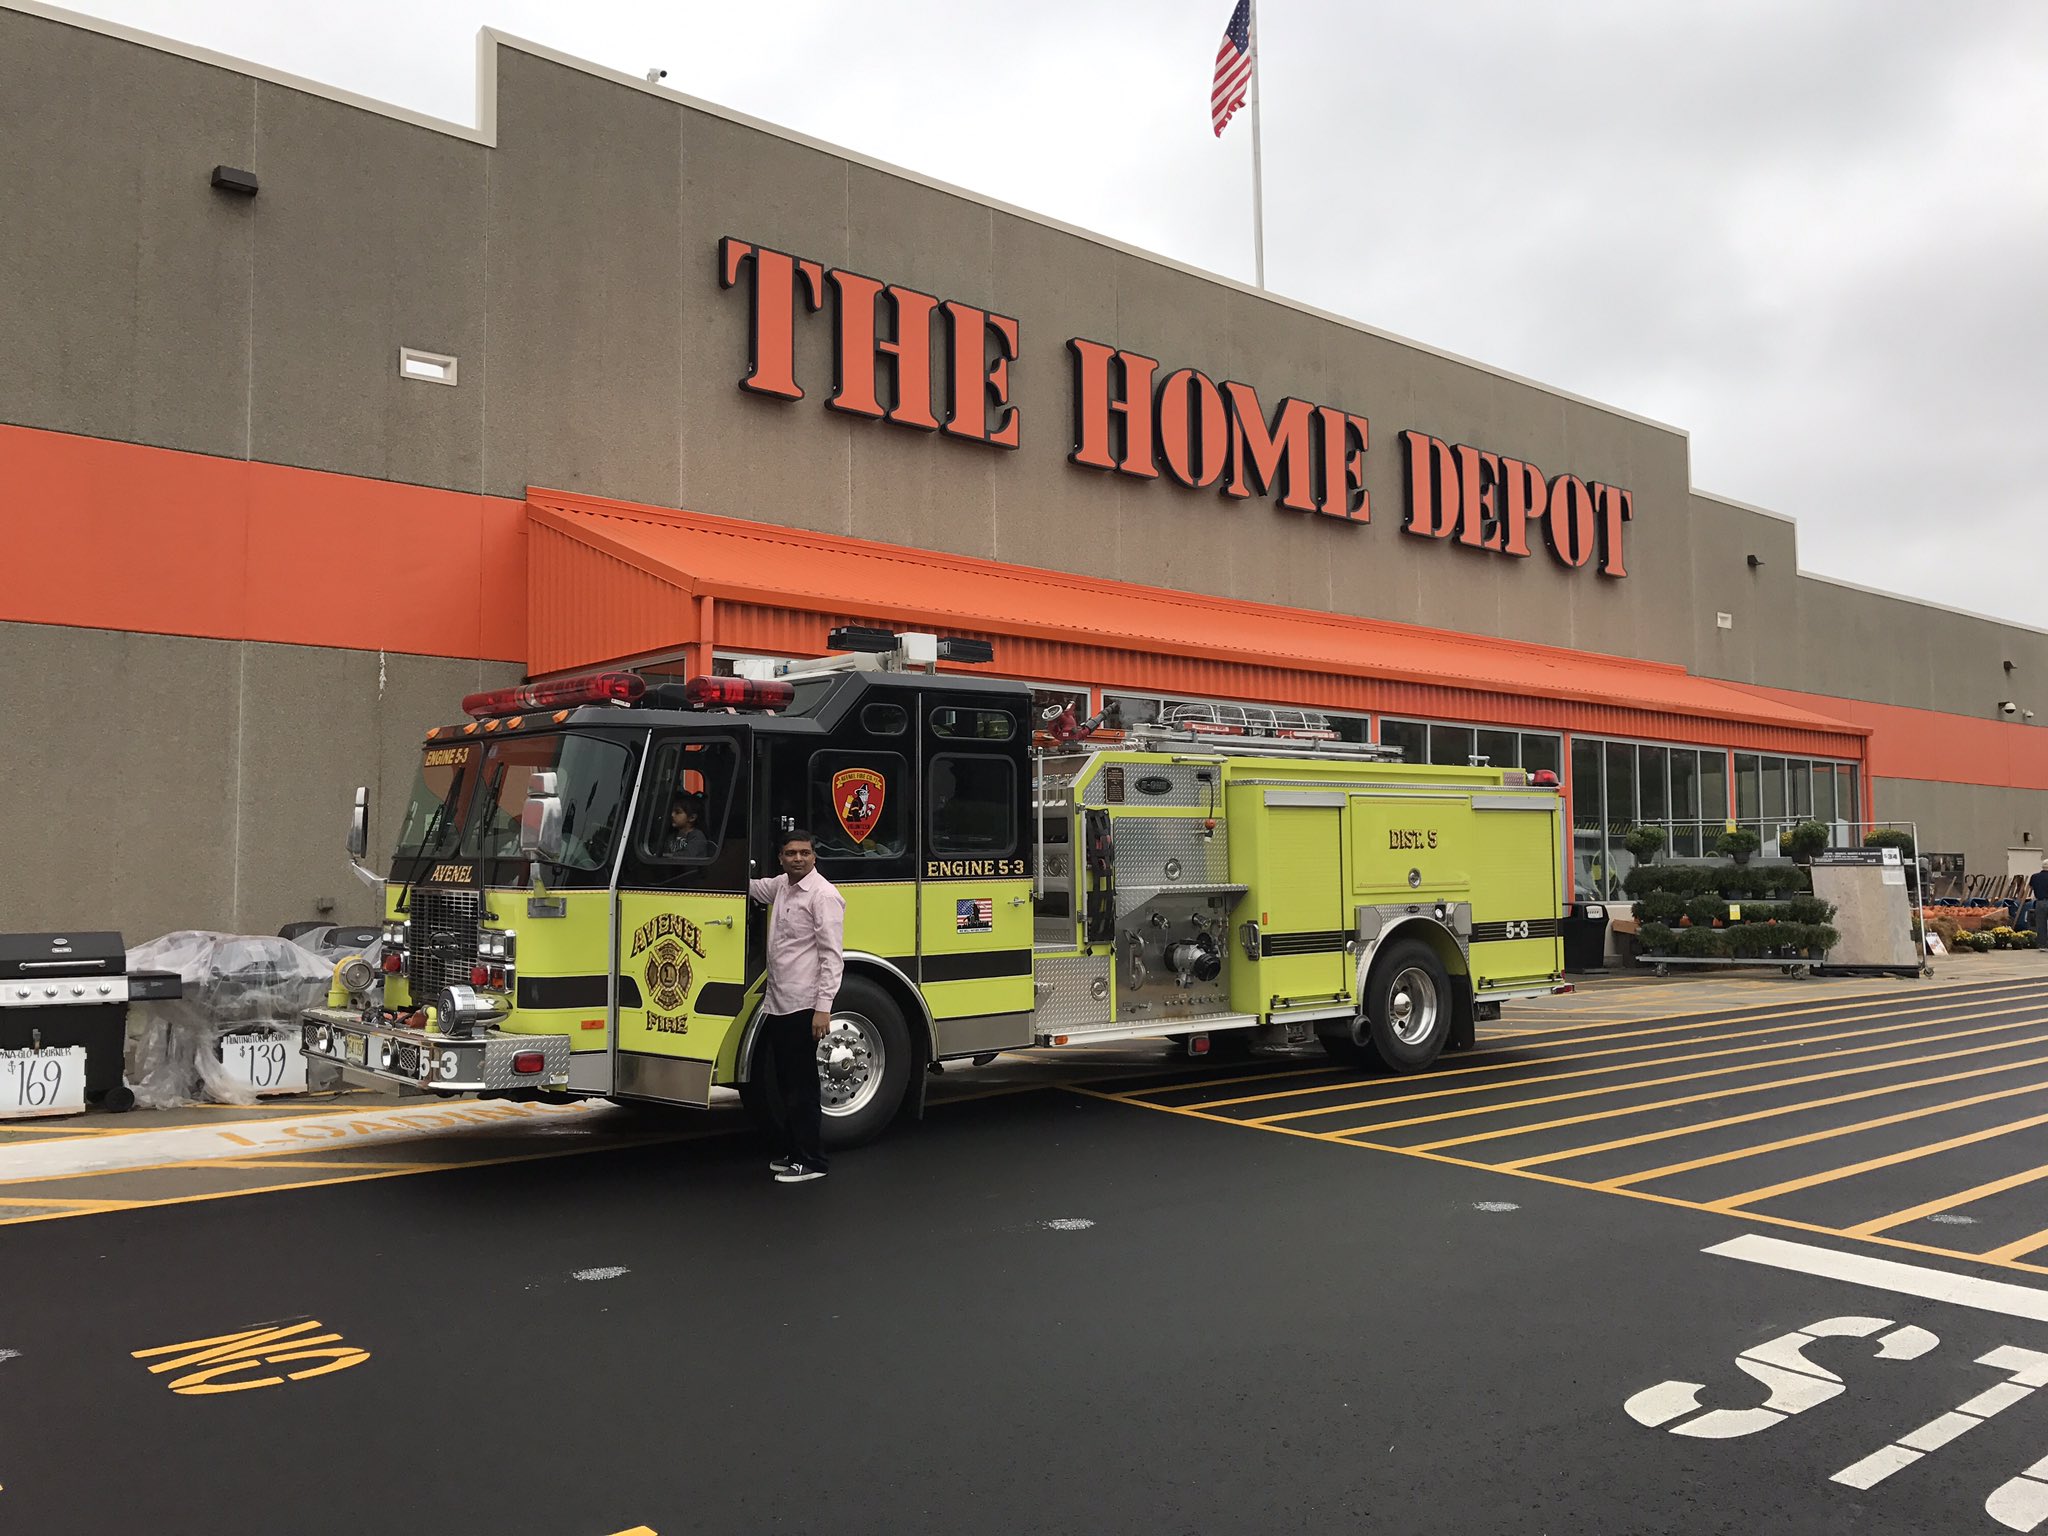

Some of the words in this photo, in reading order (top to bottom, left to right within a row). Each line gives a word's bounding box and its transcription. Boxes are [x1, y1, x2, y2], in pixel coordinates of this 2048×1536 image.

[718, 235, 1020, 451] THE
[1066, 337, 1371, 525] HOME
[1397, 429, 1634, 579] DEPOT
[425, 750, 454, 767] ENGINE
[455, 747, 469, 763] 5-3
[1389, 829, 1424, 849] DIST.
[1427, 829, 1438, 849] 5
[430, 864, 473, 883] AVENEL
[927, 860, 995, 877] ENGINE
[998, 859, 1024, 875] 5-3
[630, 913, 706, 959] AVENEL
[1506, 921, 1529, 939] 5-3
[646, 1010, 688, 1035] FIRE
[40, 1047, 72, 1058] BURNER
[420, 1047, 458, 1079] 5-3
[239, 1043, 286, 1087] $139
[8, 1059, 62, 1106] $169
